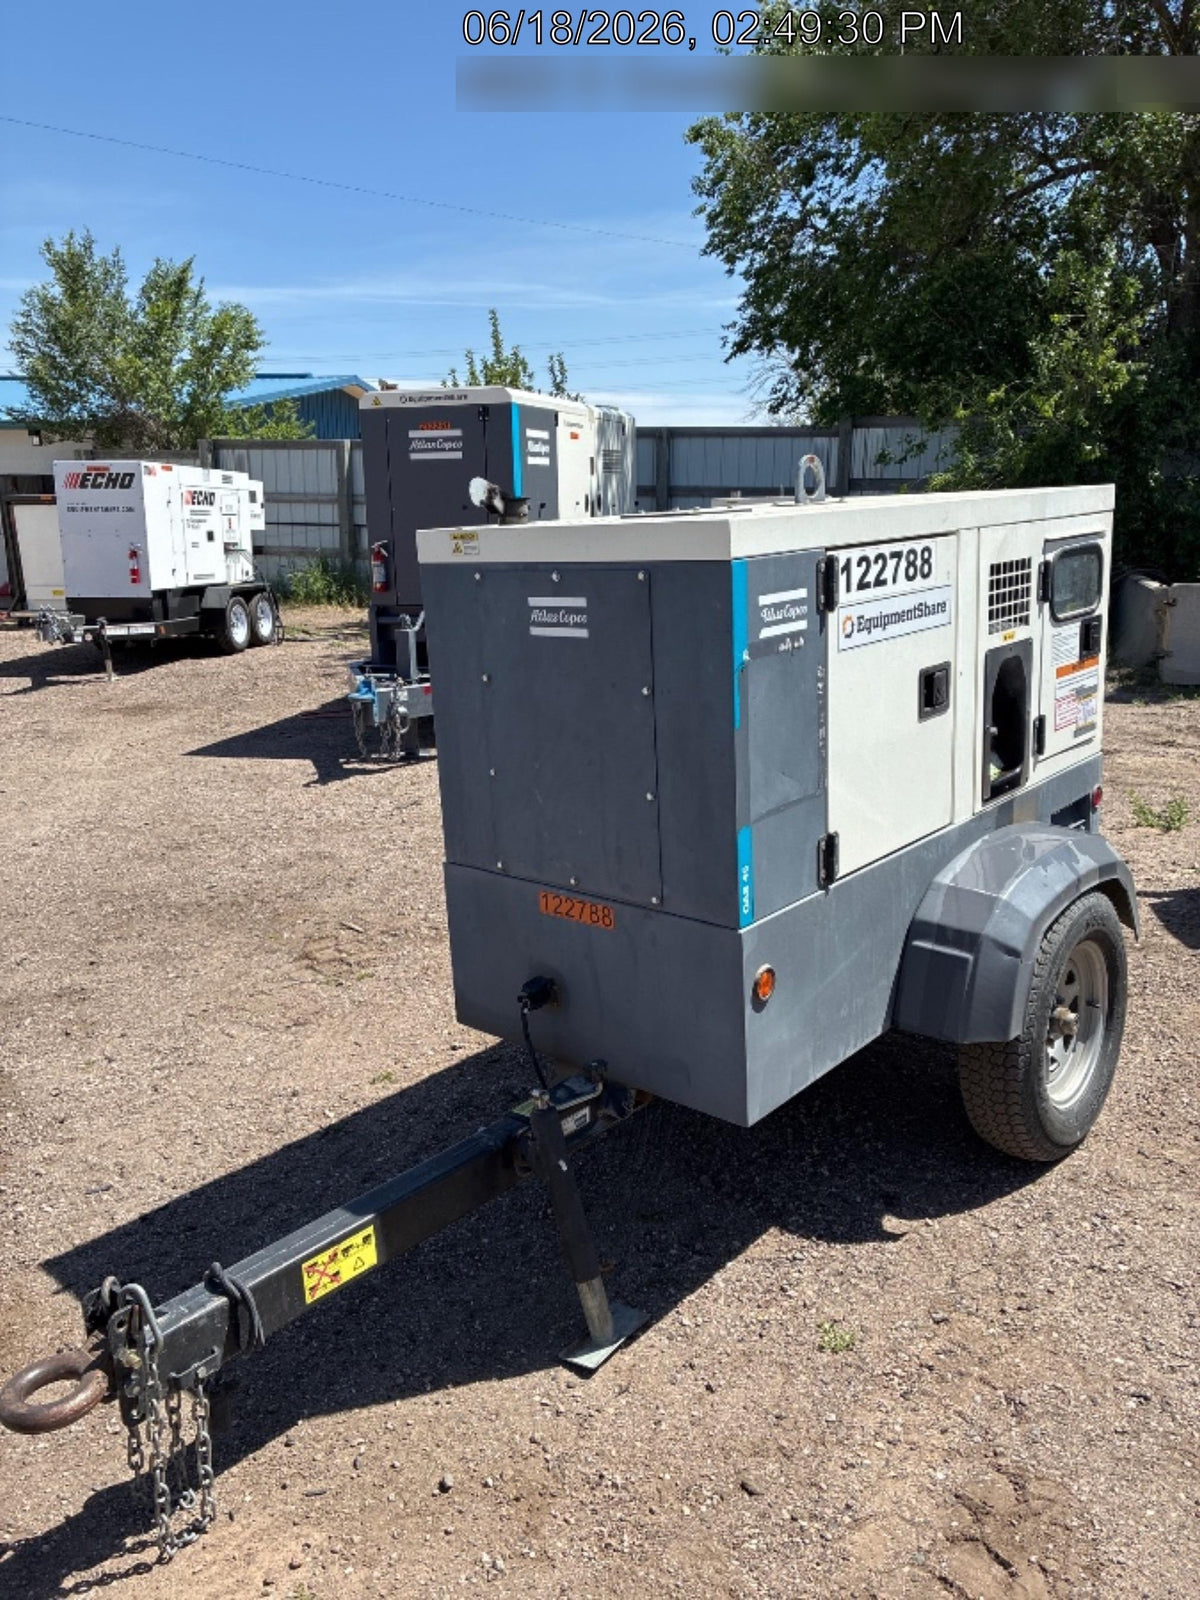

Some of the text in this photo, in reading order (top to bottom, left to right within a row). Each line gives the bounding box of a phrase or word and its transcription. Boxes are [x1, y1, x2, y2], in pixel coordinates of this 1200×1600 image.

[79, 472, 135, 490] ECHO
[191, 490, 216, 506] ECHO
[840, 545, 933, 594] 122788
[856, 600, 947, 634] EquipmentShare
[541, 892, 613, 928] 122788
